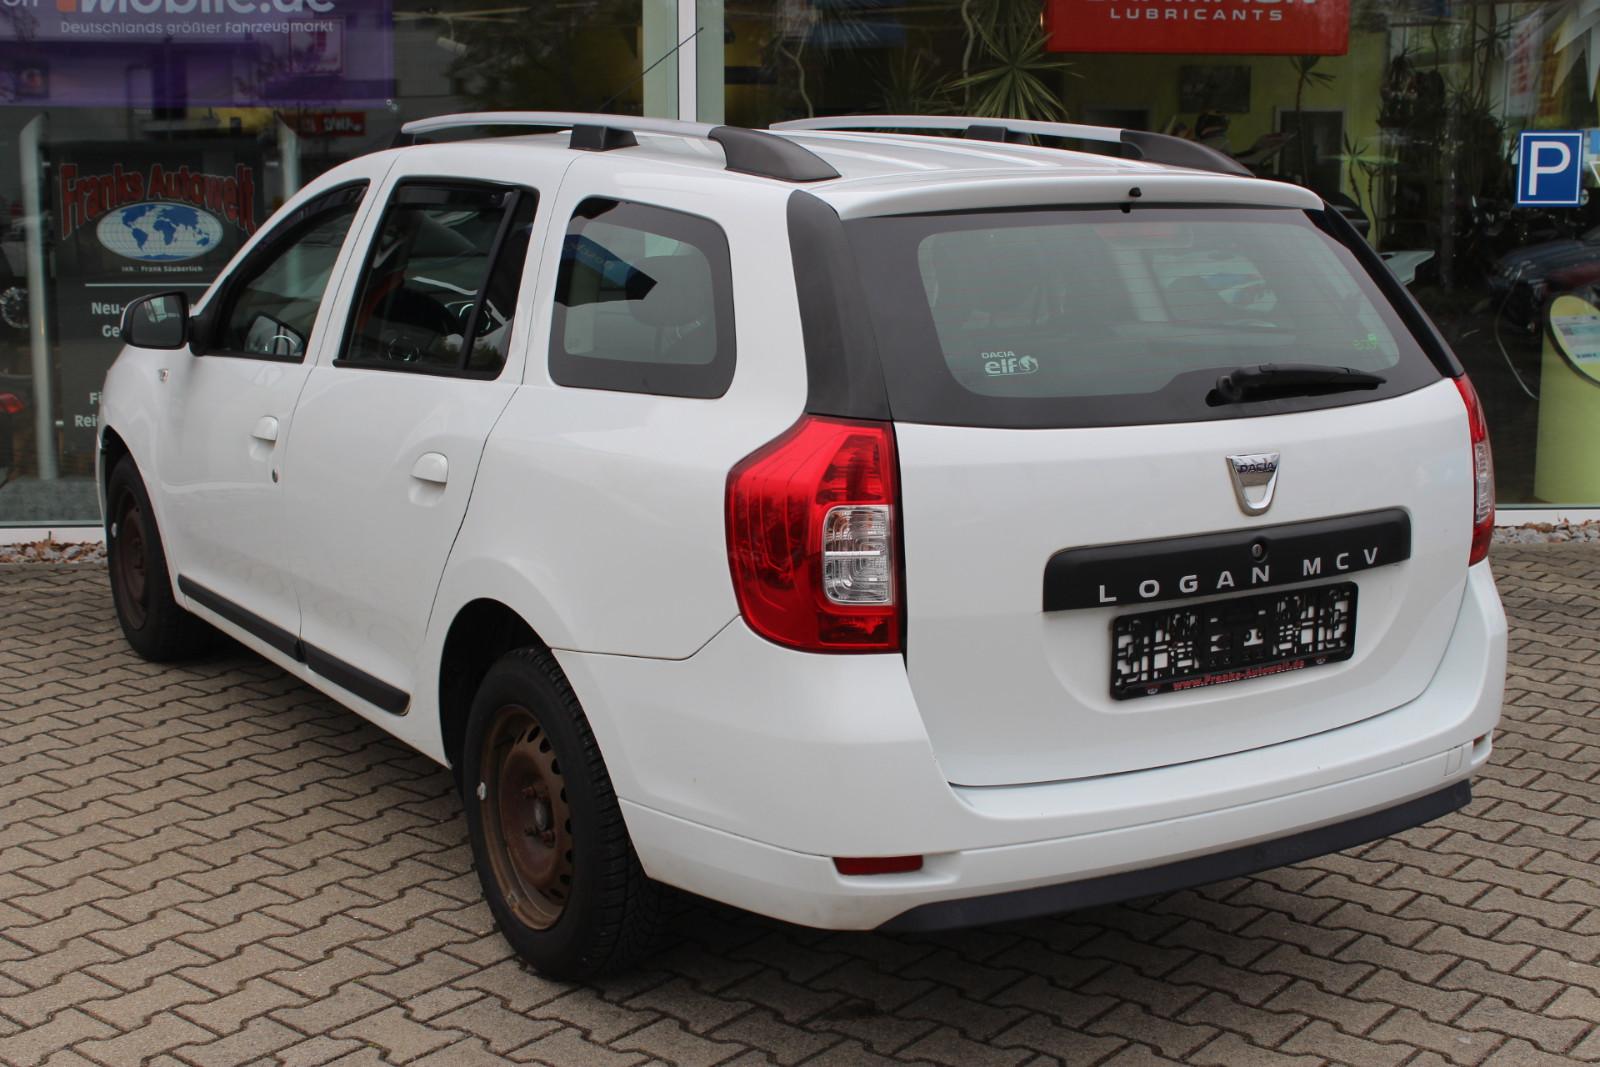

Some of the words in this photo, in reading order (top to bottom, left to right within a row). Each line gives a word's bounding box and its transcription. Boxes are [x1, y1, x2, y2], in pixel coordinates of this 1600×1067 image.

[1110, 8, 1283, 21] LUBRICANTS
[61, 21, 162, 33] Deutschlands
[166, 22, 221, 34] größter
[225, 20, 334, 34] Fahrzeugmarkt
[1528, 141, 1571, 195] P
[58, 163, 144, 241] Franks
[147, 163, 258, 237] Autowelt
[981, 350, 1016, 359] DACIA
[1238, 461, 1277, 474] DACIA
[1099, 565, 1270, 603] LOGAN
[1302, 547, 1378, 576] MCV
